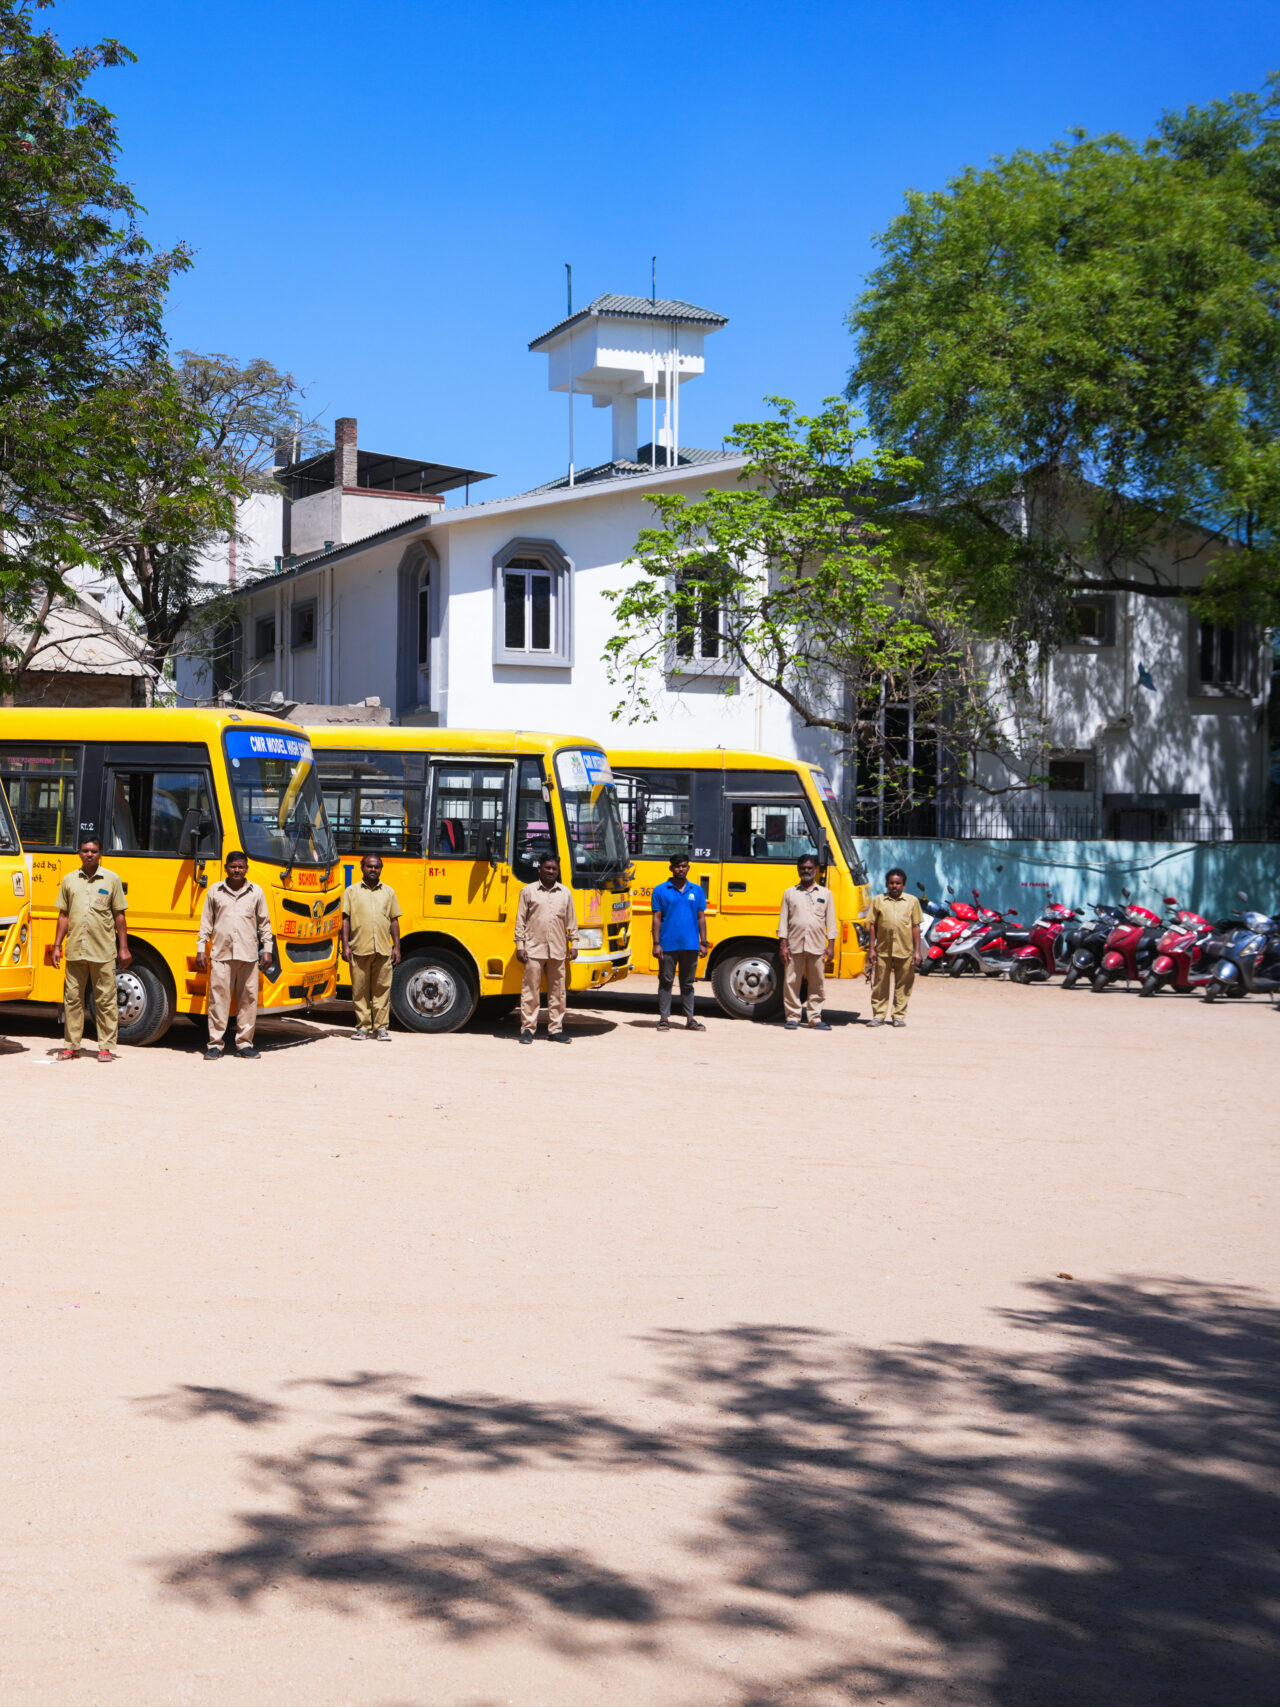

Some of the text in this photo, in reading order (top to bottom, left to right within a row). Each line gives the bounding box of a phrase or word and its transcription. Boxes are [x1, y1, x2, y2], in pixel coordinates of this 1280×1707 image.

[249, 736, 267, 752] CMR
[265, 737, 288, 755] MODEL
[694, 848, 711, 857] RT-3
[429, 867, 445, 877] RT-1
[298, 872, 318, 886] SCHOOL
